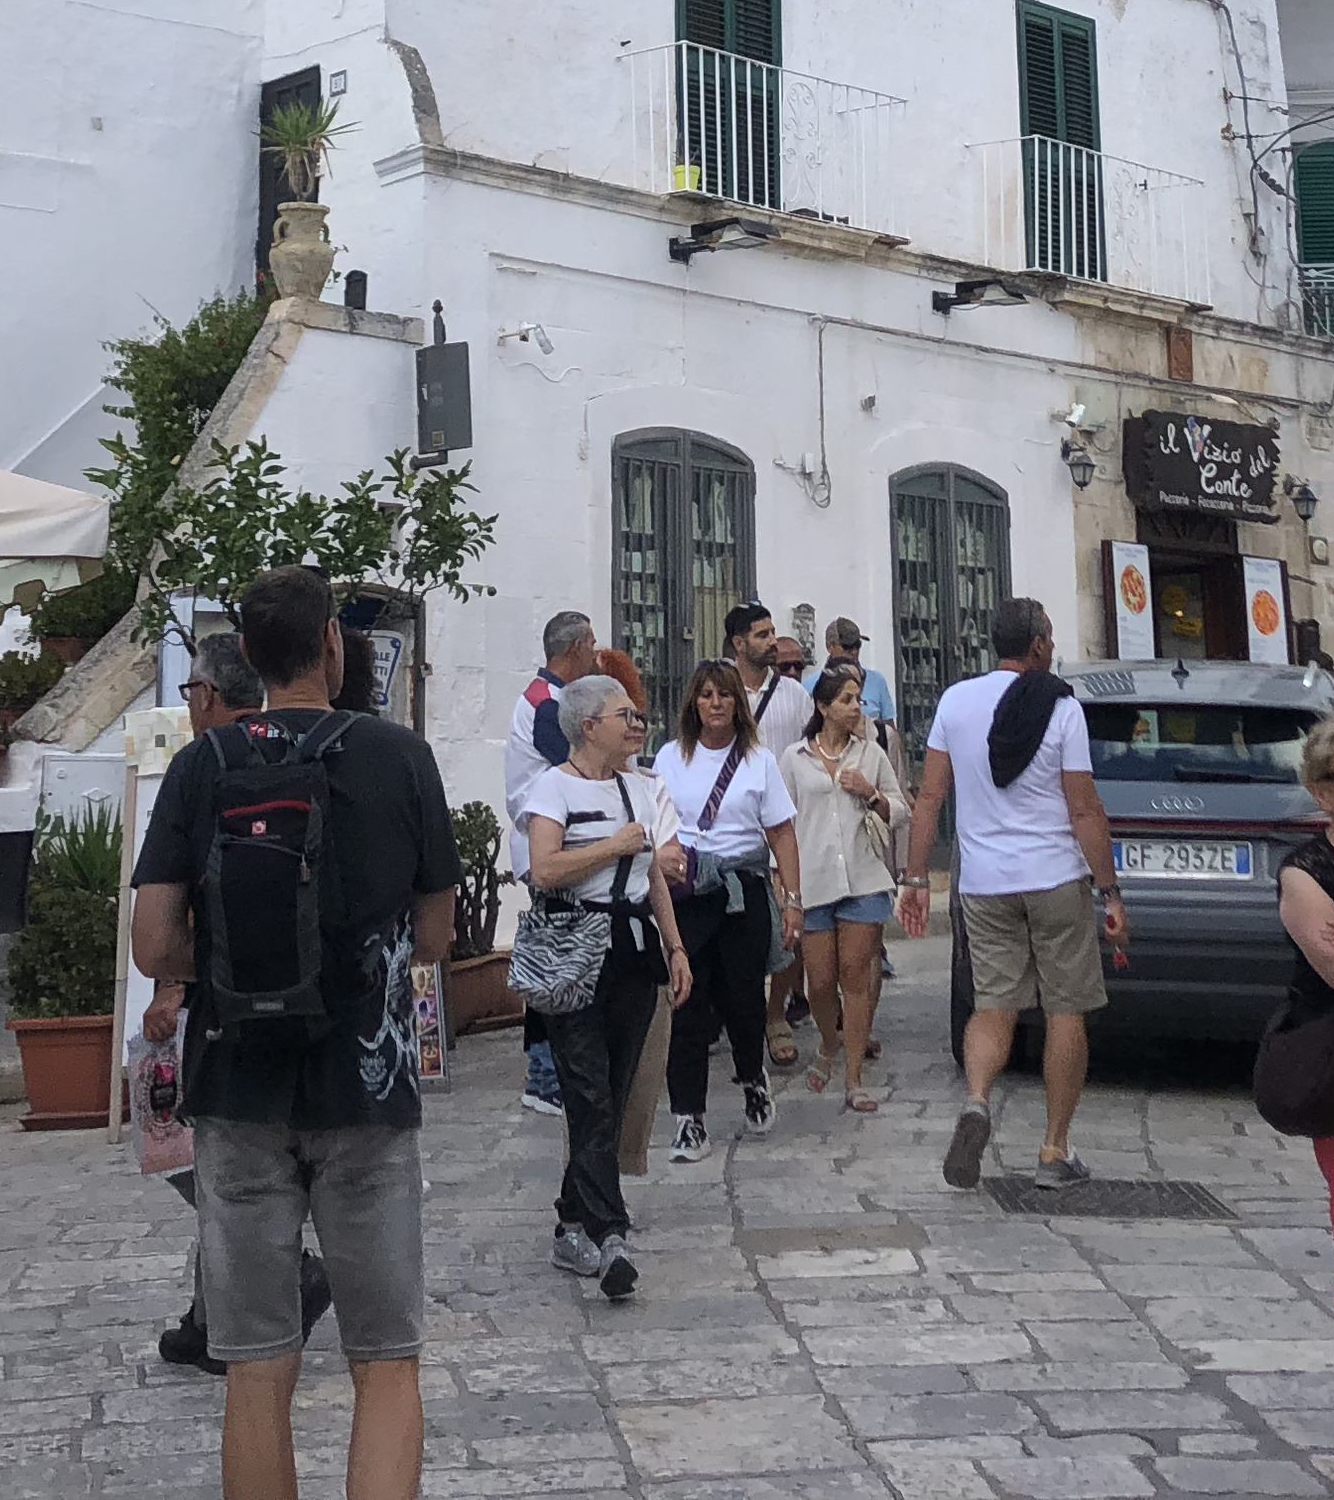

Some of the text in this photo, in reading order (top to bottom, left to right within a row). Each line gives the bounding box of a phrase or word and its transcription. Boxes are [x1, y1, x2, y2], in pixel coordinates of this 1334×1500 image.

[1160, 420, 1271, 478] il Vizio del
[1199, 463, 1253, 498] Conte
[1125, 843, 1152, 870] GF
